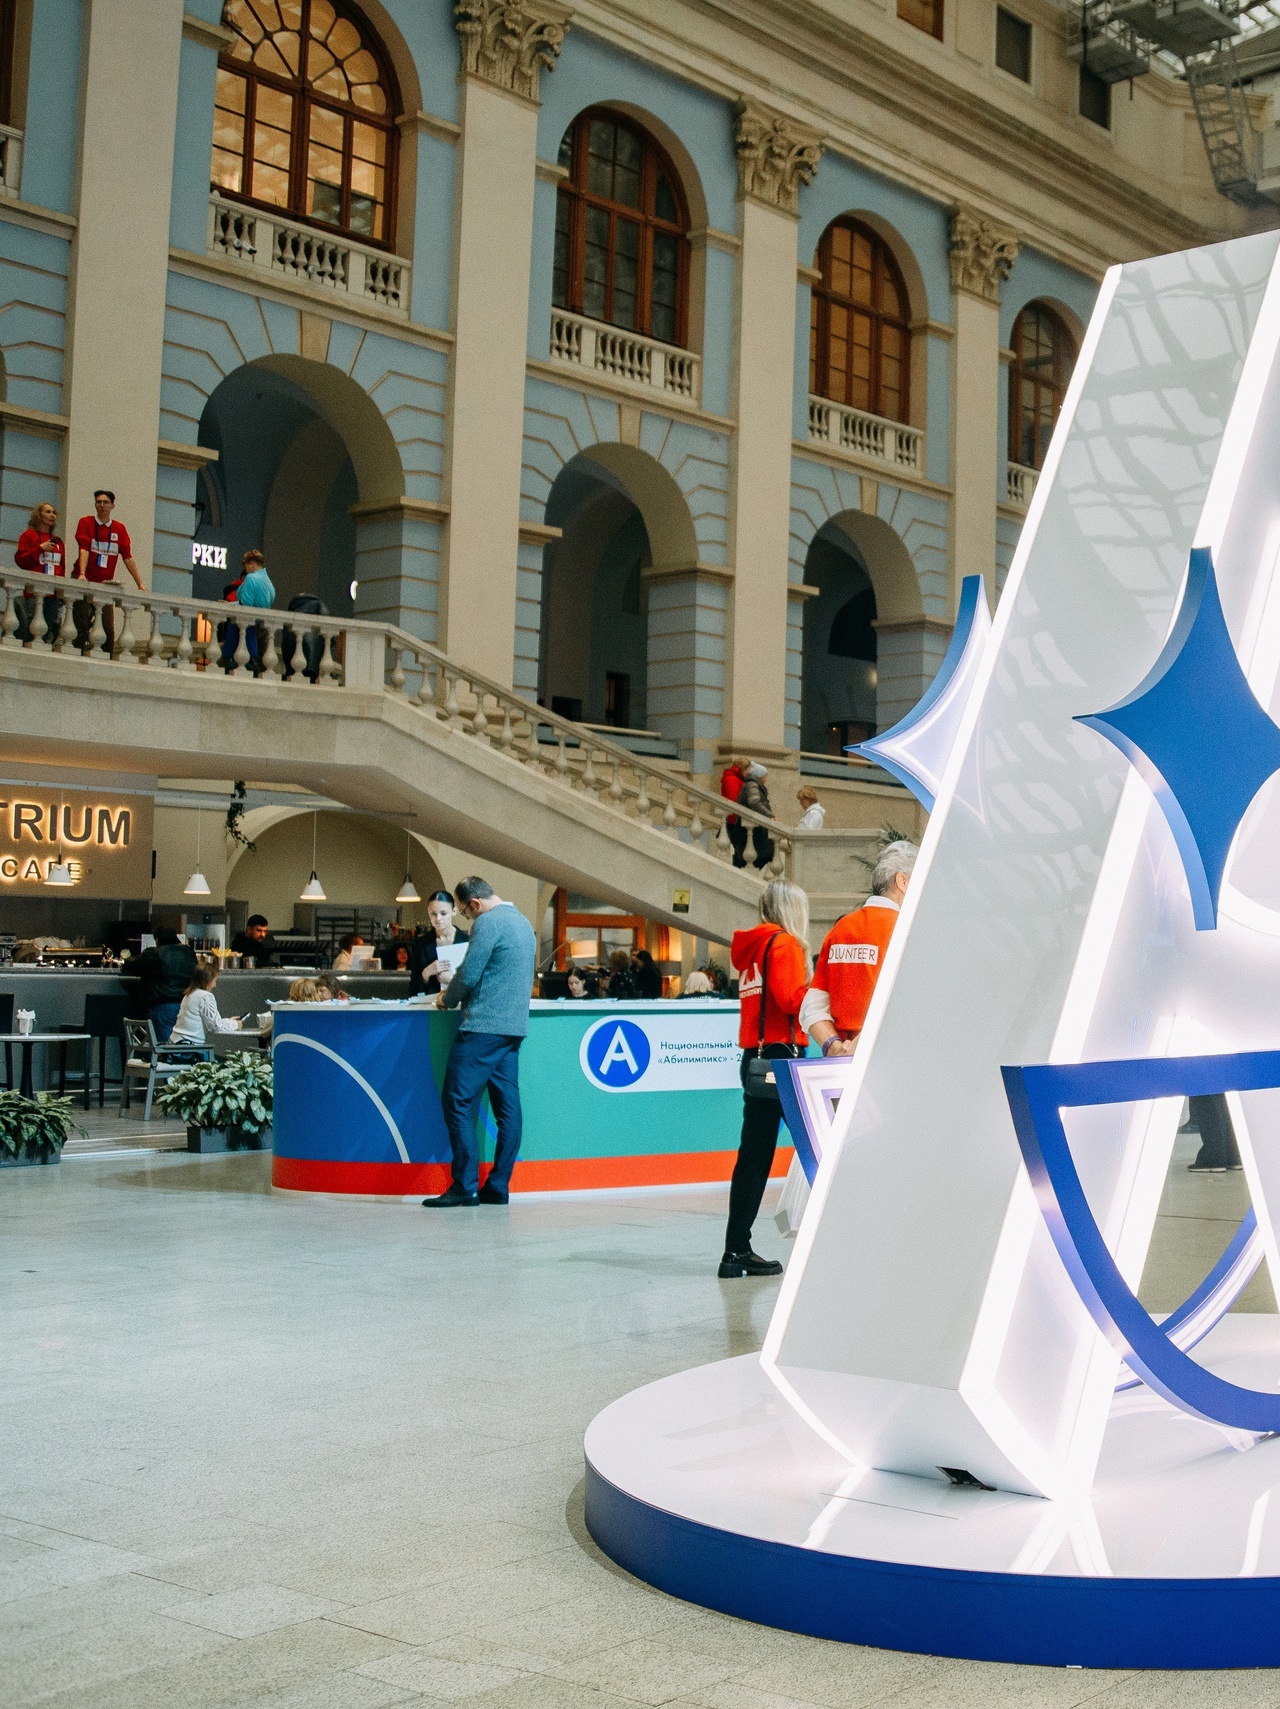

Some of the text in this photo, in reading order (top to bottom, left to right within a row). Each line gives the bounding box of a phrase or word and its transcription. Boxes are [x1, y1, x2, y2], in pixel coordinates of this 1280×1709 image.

[192, 543, 228, 570] РКИ
[829, 947, 876, 961] OLUNTEER
[660, 1040, 733, 1050] Национальный
[657, 1054, 728, 1064] «Абилимпикс»
